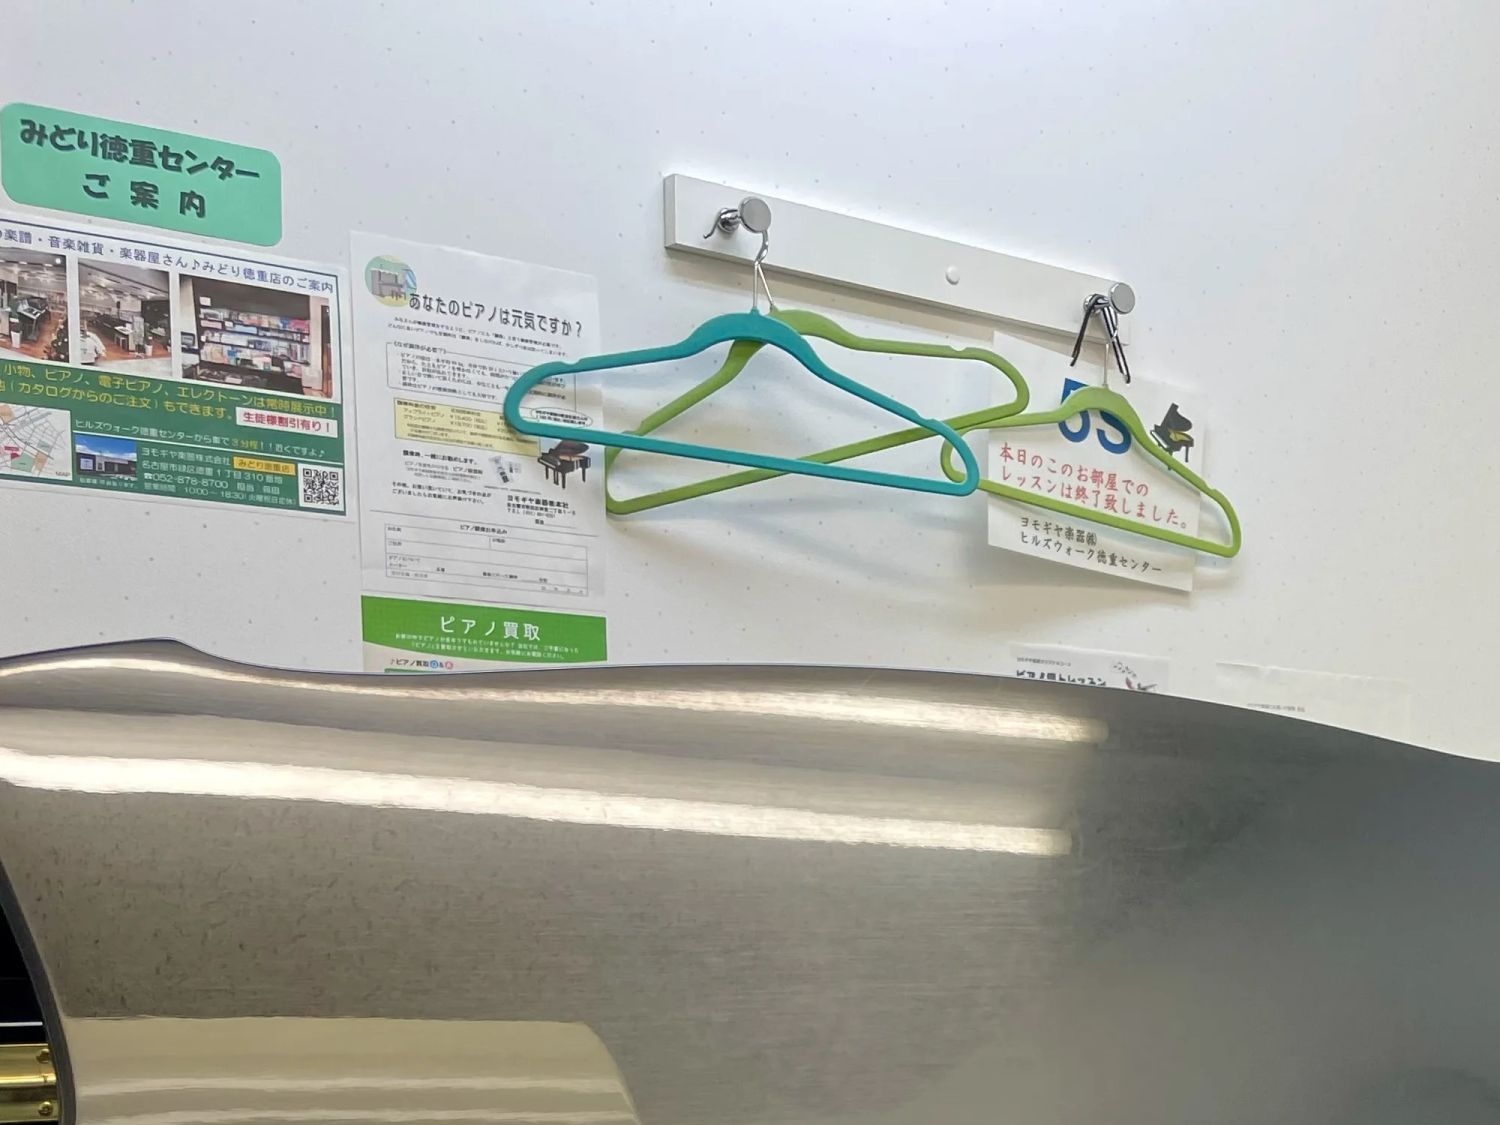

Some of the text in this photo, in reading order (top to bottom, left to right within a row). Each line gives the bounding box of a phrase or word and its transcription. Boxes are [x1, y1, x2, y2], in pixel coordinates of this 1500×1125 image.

[20, 118, 261, 181] みどり徳重センター
[83, 173, 207, 218] ご案内
[0, 228, 334, 294] 楽譜・音楽雑貨・楽器屋さん♪みどり徳重店のご案内
[408, 293, 582, 337] あなたのピアノは元気ですか？
[243, 411, 331, 433] 生徒様割引有り！
[1000, 442, 1149, 497] 本日のこのお部屋での
[1001, 465, 1187, 529] レッスンは終了致しました。
[1020, 531, 1162, 573] ヒルズウォーク徳重センター
[441, 615, 541, 641] ピアノ買取
